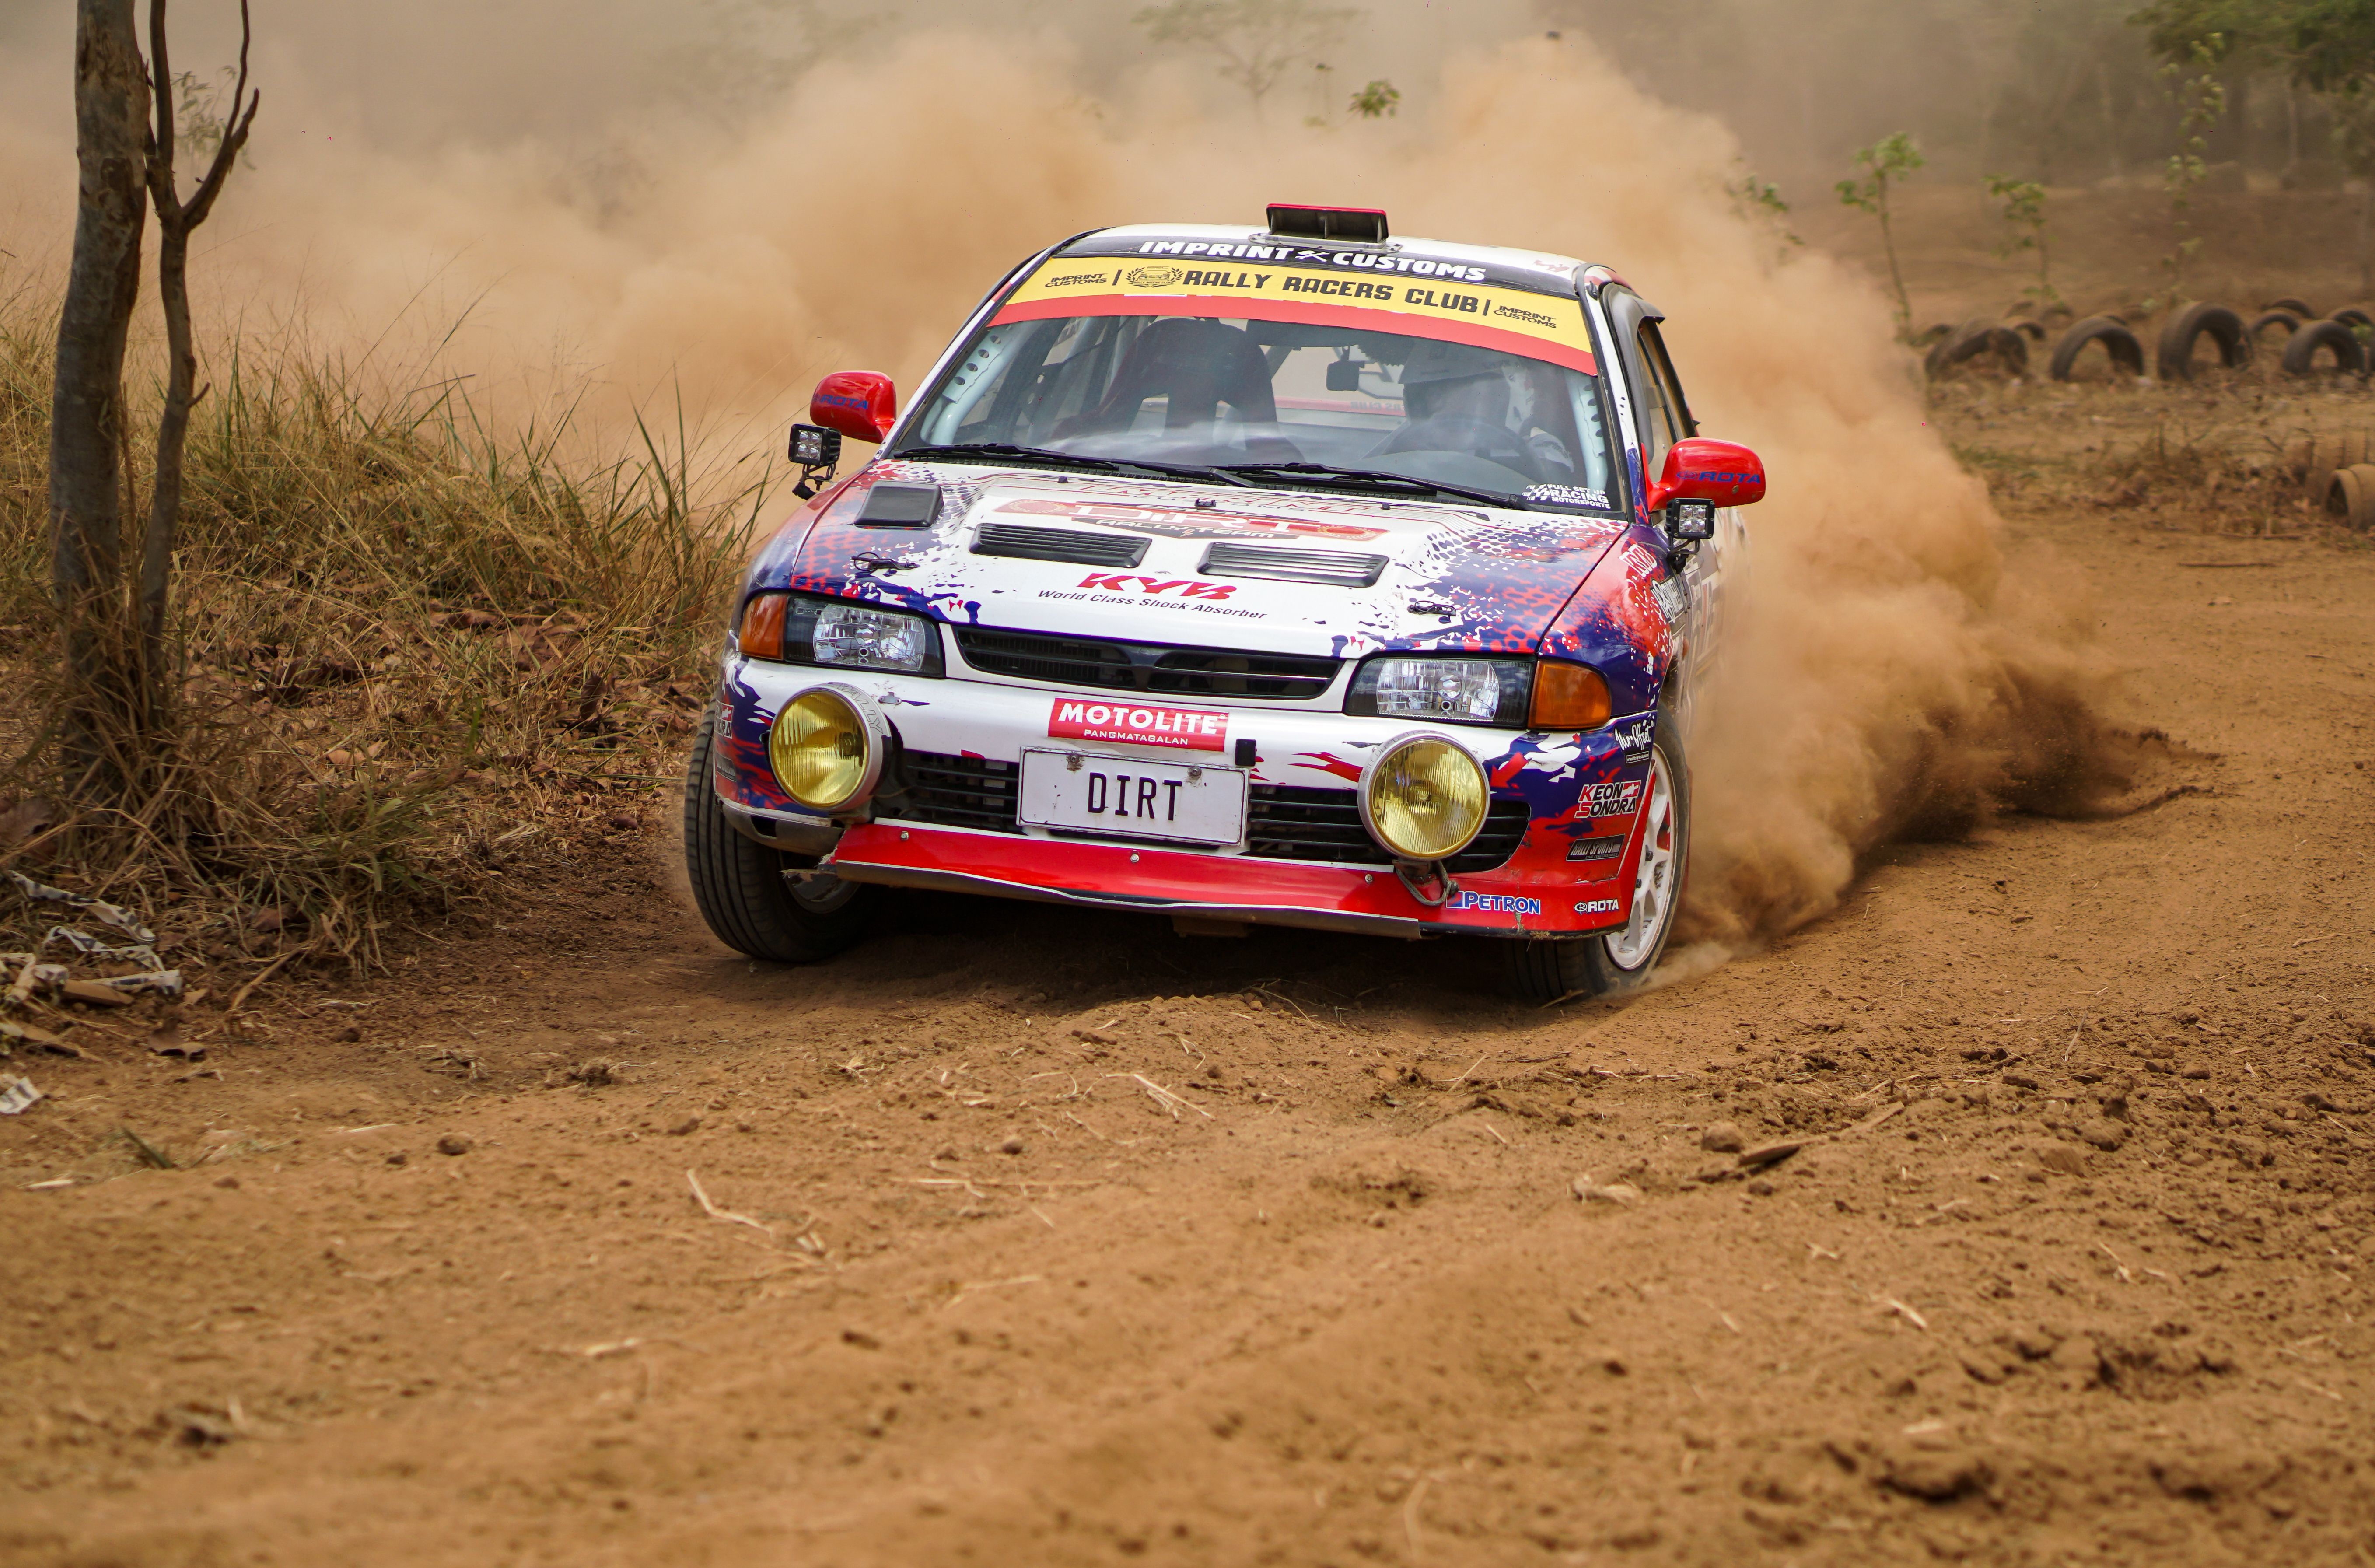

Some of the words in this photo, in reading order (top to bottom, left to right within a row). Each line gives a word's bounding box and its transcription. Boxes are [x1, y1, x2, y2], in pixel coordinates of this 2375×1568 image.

[1139, 241, 1294, 260] IMPRINT
[1333, 252, 1486, 281] CUSTOMS
[1045, 278, 1107, 288] CUSTOMS
[1050, 273, 1109, 283] IMPRINT
[1182, 270, 1272, 289] RALLY
[1282, 276, 1394, 301] RACERS
[1405, 287, 1478, 313] CLUB
[1493, 310, 1557, 329] CUSTOMS
[1498, 305, 1555, 322] IMPRINT
[821, 394, 868, 410] ROTA
[1699, 471, 1761, 484] ROTA
[1550, 489, 1609, 504] RACING
[1551, 497, 1611, 509] MOTORSPORTS
[1096, 519, 1181, 531] RALLY
[1198, 527, 1274, 538] TEAM
[1077, 573, 1237, 600] KYB
[1038, 590, 1087, 600] World
[1091, 594, 1135, 605] Class
[1139, 599, 1189, 611] Shock
[1192, 604, 1267, 620] Absorber
[1058, 703, 1217, 734] MOTOLITE
[1084, 729, 1188, 745] PANGMATAGALAN
[1088, 772, 1182, 821] DIRT
[1578, 782, 1624, 802] KEON
[1574, 798, 1636, 818] SONDRA
[1570, 842, 1591, 856] RALLY
[1589, 840, 1613, 855] SPORTS
[1464, 891, 1541, 914] PETRON
[1588, 899, 1619, 913] ROTA
